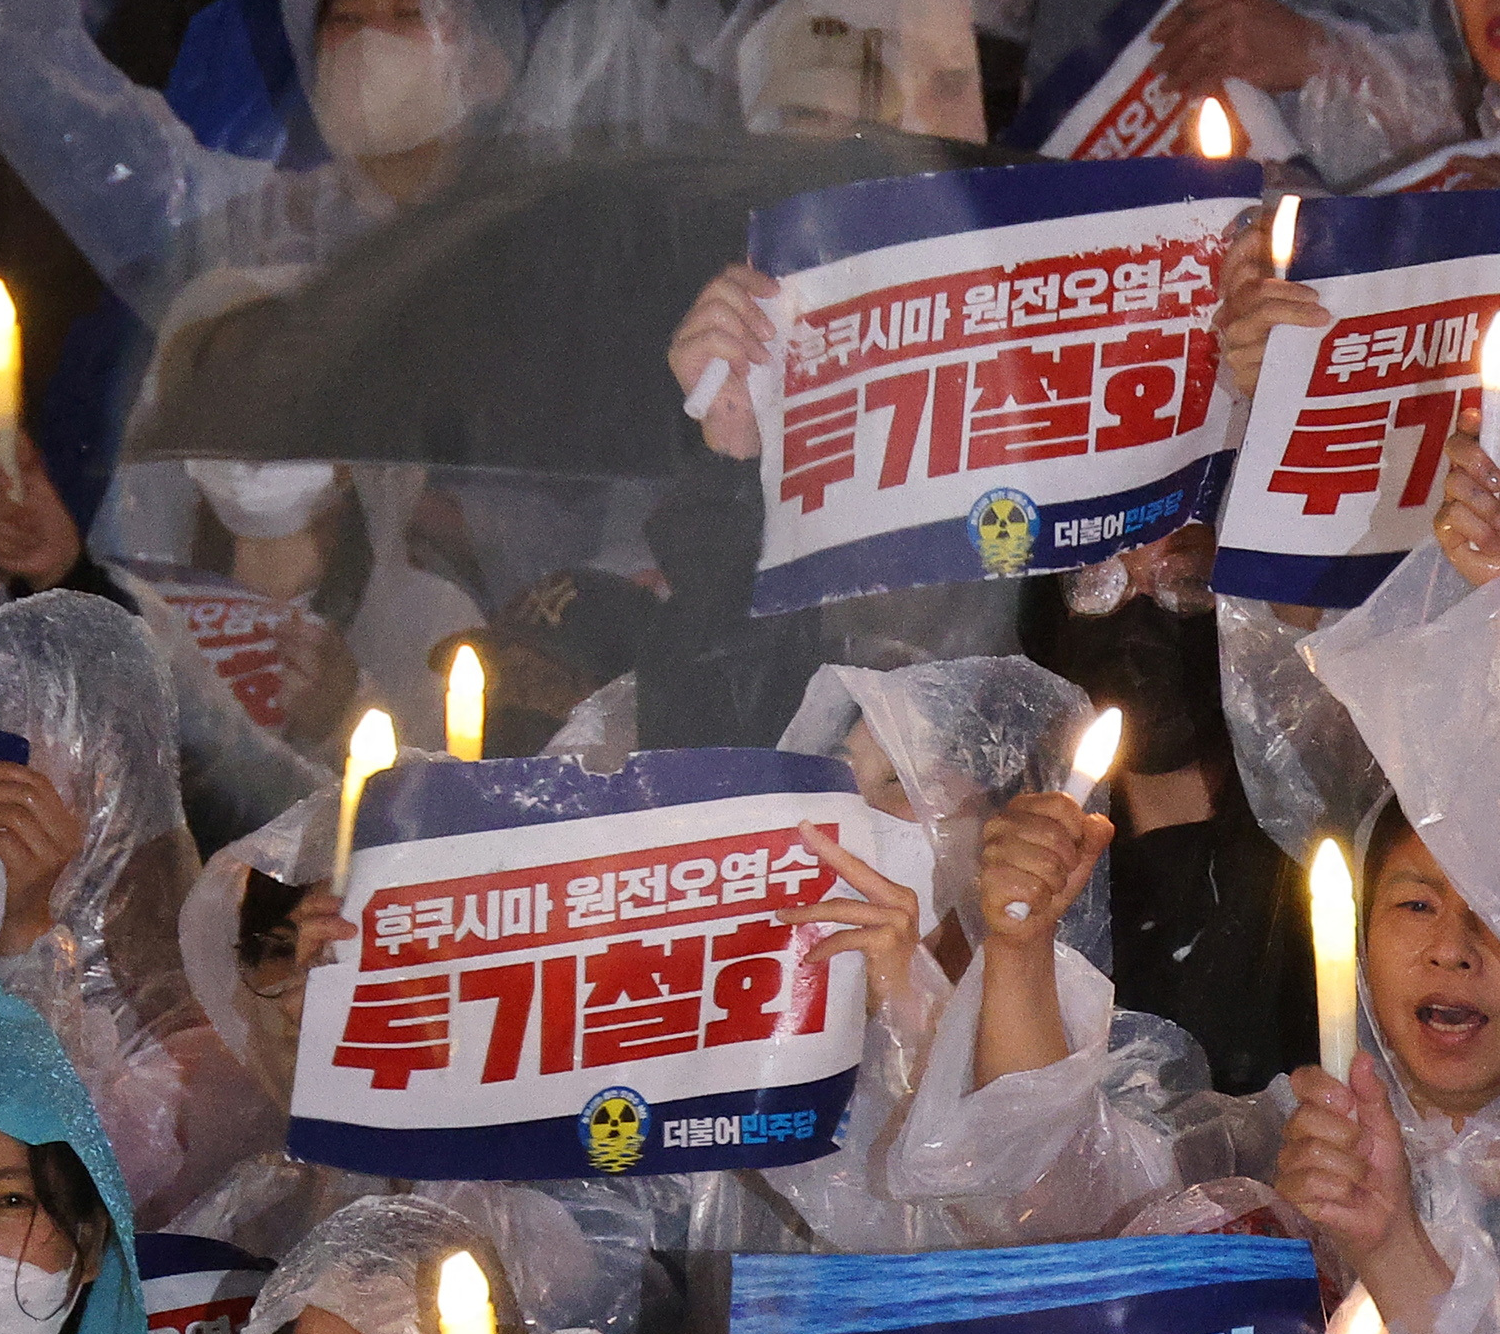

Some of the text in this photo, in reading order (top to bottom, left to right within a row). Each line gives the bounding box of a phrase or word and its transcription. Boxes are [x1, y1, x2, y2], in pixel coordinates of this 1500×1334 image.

[788, 256, 1215, 375] 후쿠시마 원전오염수
[1325, 312, 1481, 385] 후쿠시마
[780, 328, 1221, 516] 투기철회
[1054, 489, 1184, 550] 더불어민주당
[374, 846, 819, 957] 후쿠시마 원전오염수
[331, 919, 831, 1090] 투기철회
[663, 1109, 818, 1150] 더불어민주당
